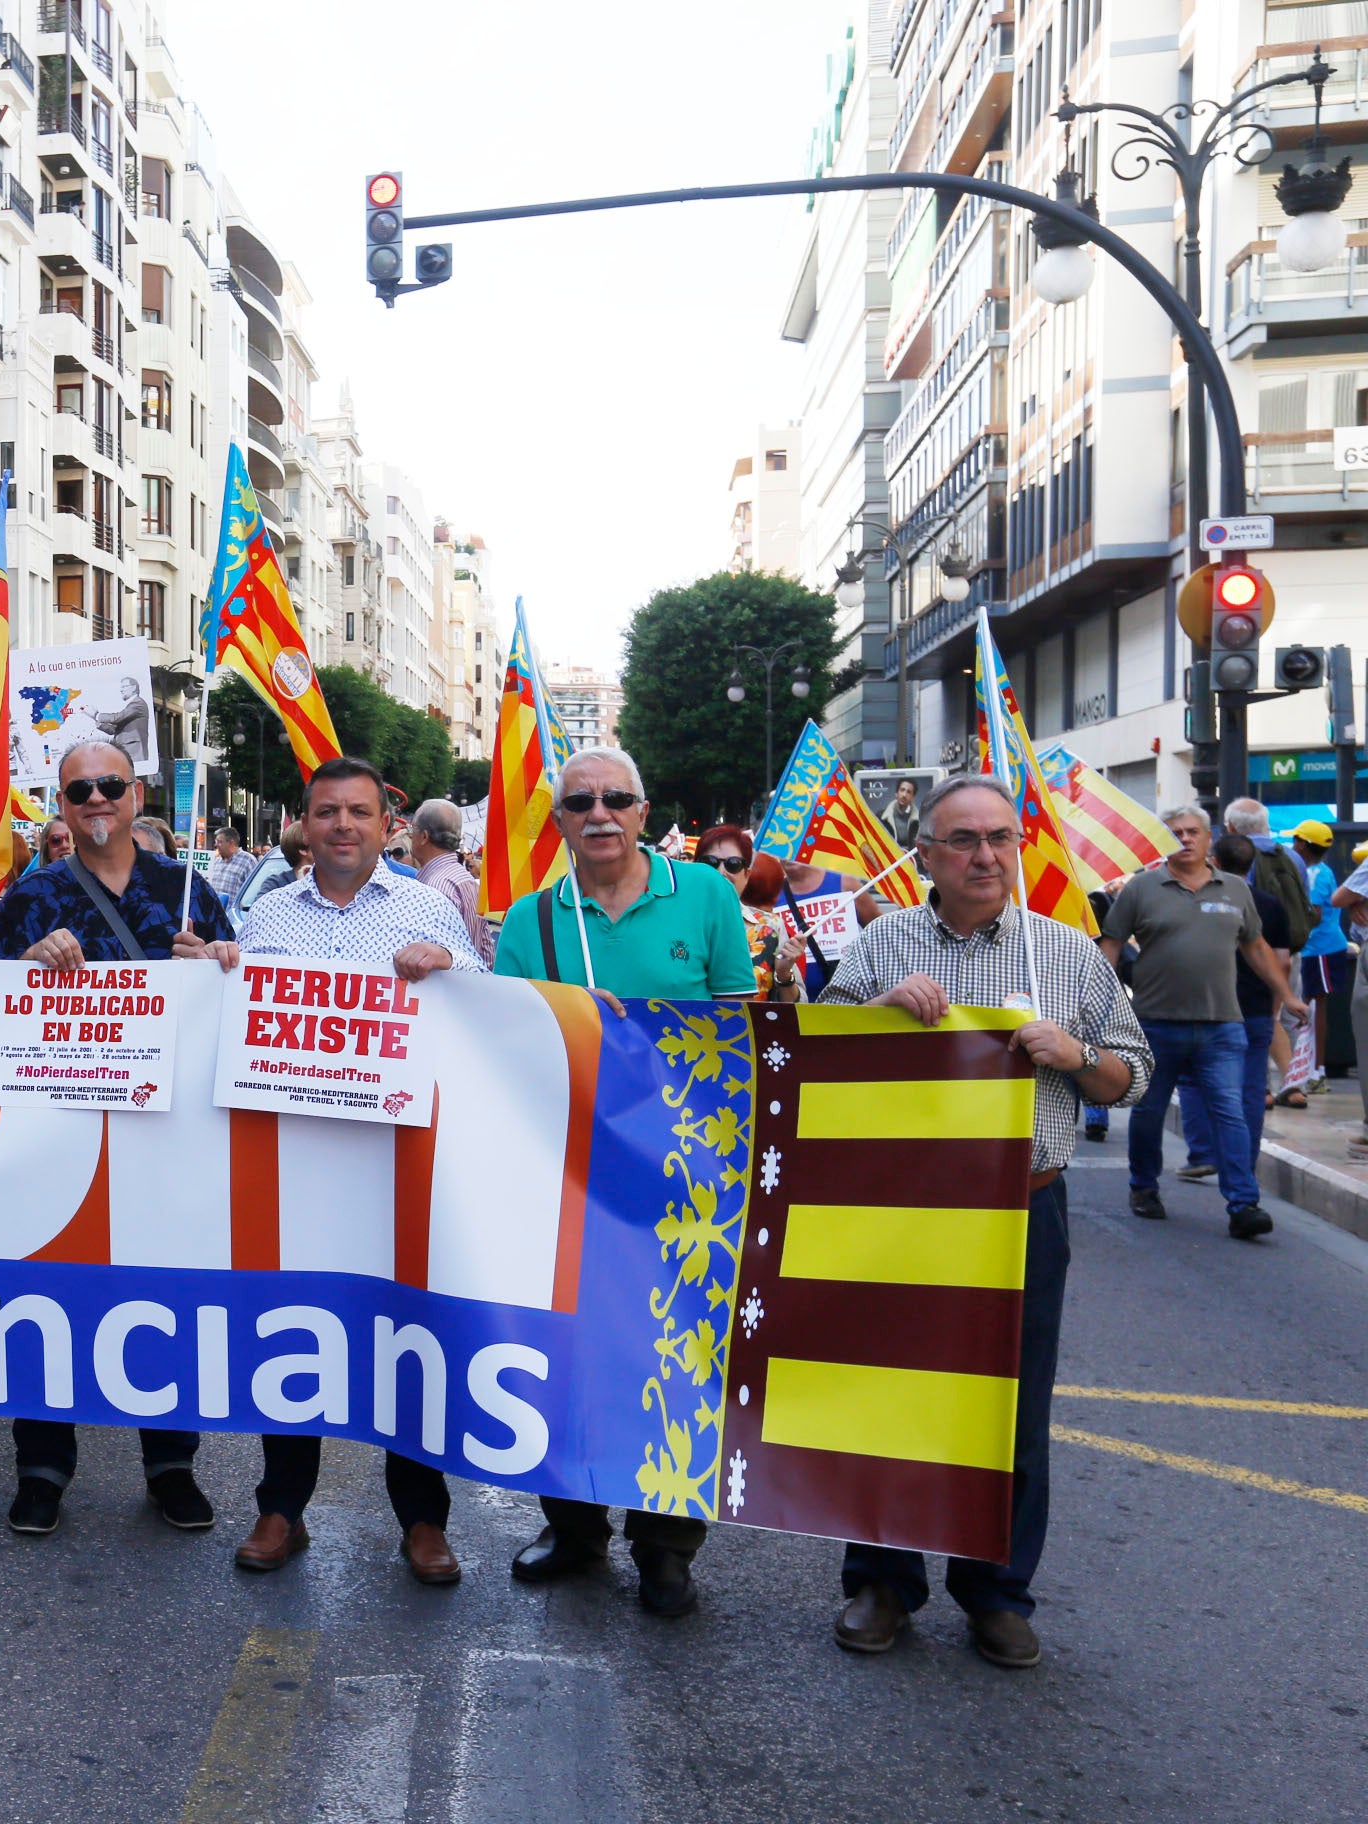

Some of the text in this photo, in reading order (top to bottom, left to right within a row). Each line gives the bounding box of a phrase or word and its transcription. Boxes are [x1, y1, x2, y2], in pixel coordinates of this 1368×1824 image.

[29, 655, 122, 674] A la cua en inversions
[243, 965, 420, 1016] TERUEL
[5, 994, 165, 1017] LO PUBLICADO
[42, 1022, 124, 1043] EN BOE
[245, 1009, 410, 1060] EXISTE
[16, 1065, 130, 1080] #NoPierdaselTren
[249, 1059, 381, 1084] #NoPierdaselTren
[2, 1084, 35, 1092] CORREDOR
[234, 1081, 272, 1091] CORREDOR
[97, 1094, 127, 1102] SAGUNTO
[306, 1096, 335, 1105] TERUEL
[343, 1099, 378, 1109] SAGUNTO
